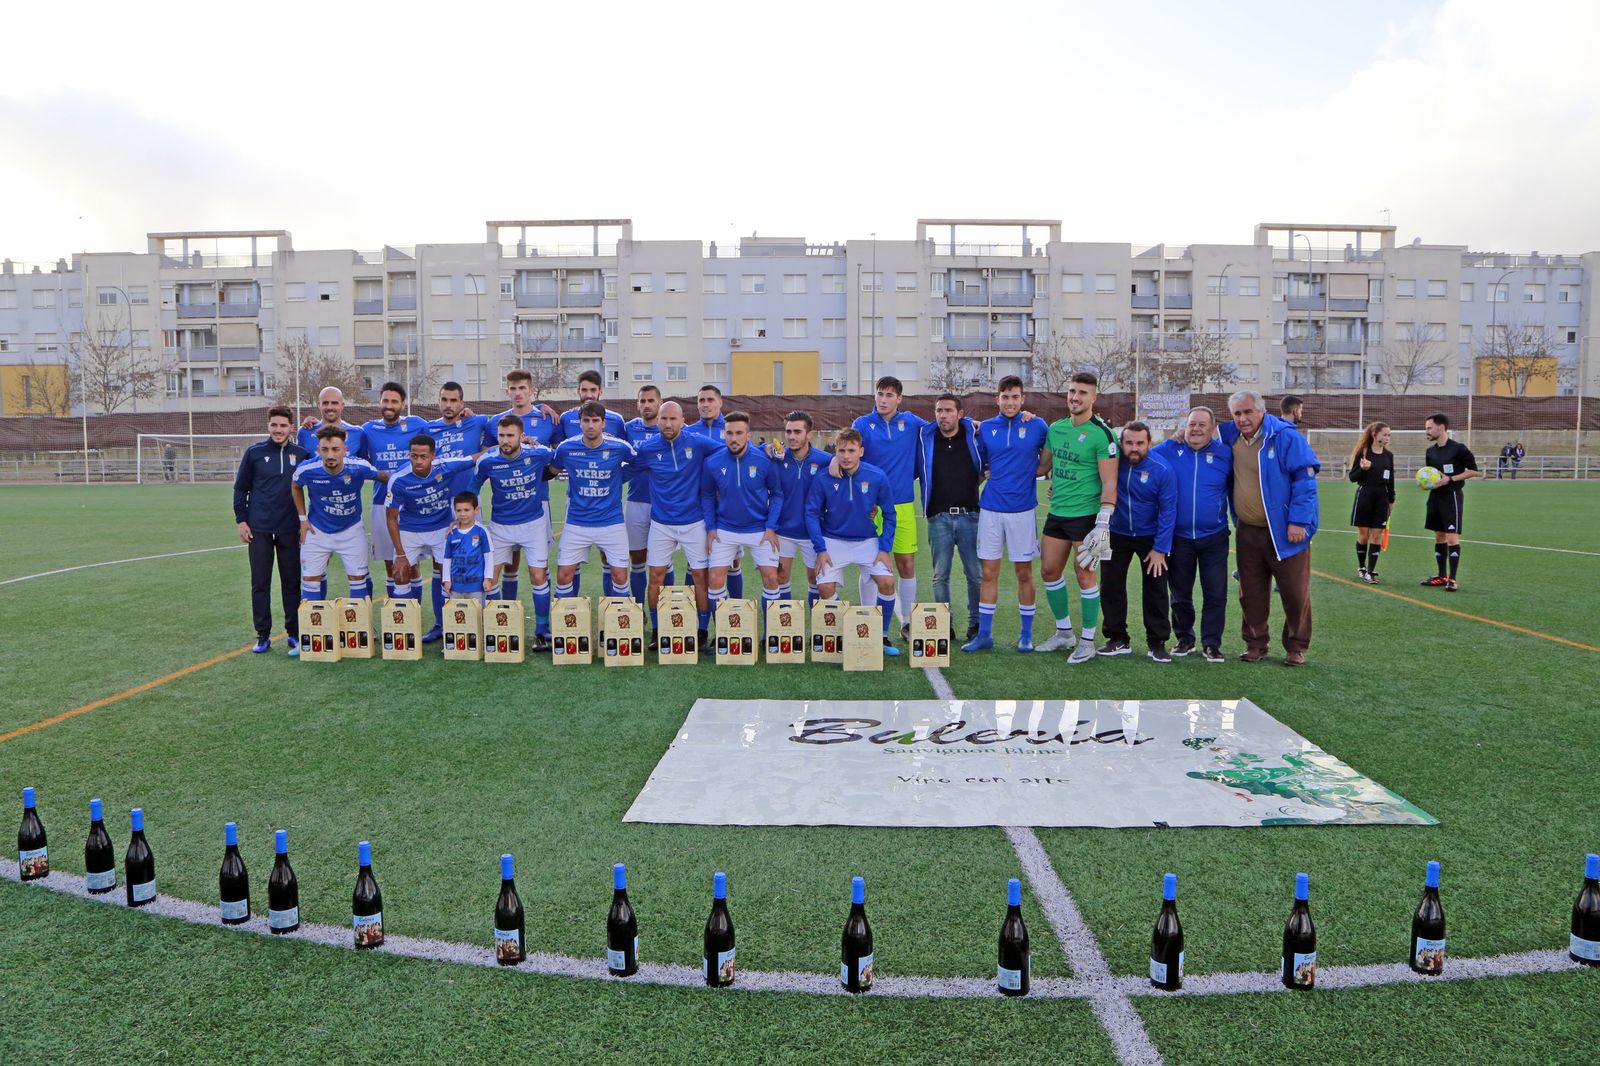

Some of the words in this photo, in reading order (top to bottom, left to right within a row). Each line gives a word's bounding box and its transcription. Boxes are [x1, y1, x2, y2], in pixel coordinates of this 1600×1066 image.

[376, 450, 410, 462] XEREZ
[388, 461, 398, 469] DE
[588, 461, 598, 469] EL
[575, 469, 611, 479] XEREZ
[500, 473, 536, 487] XEREZ
[505, 488, 537, 500] JEREZ
[578, 487, 610, 497] JEREZ
[320, 493, 356, 504] XEREZ
[323, 505, 356, 516] JEREZ
[883, 747, 996, 755] Sauvignon
[898, 775, 950, 784] Vino
[966, 775, 1006, 783] con
[1020, 776, 1071, 784] arte
